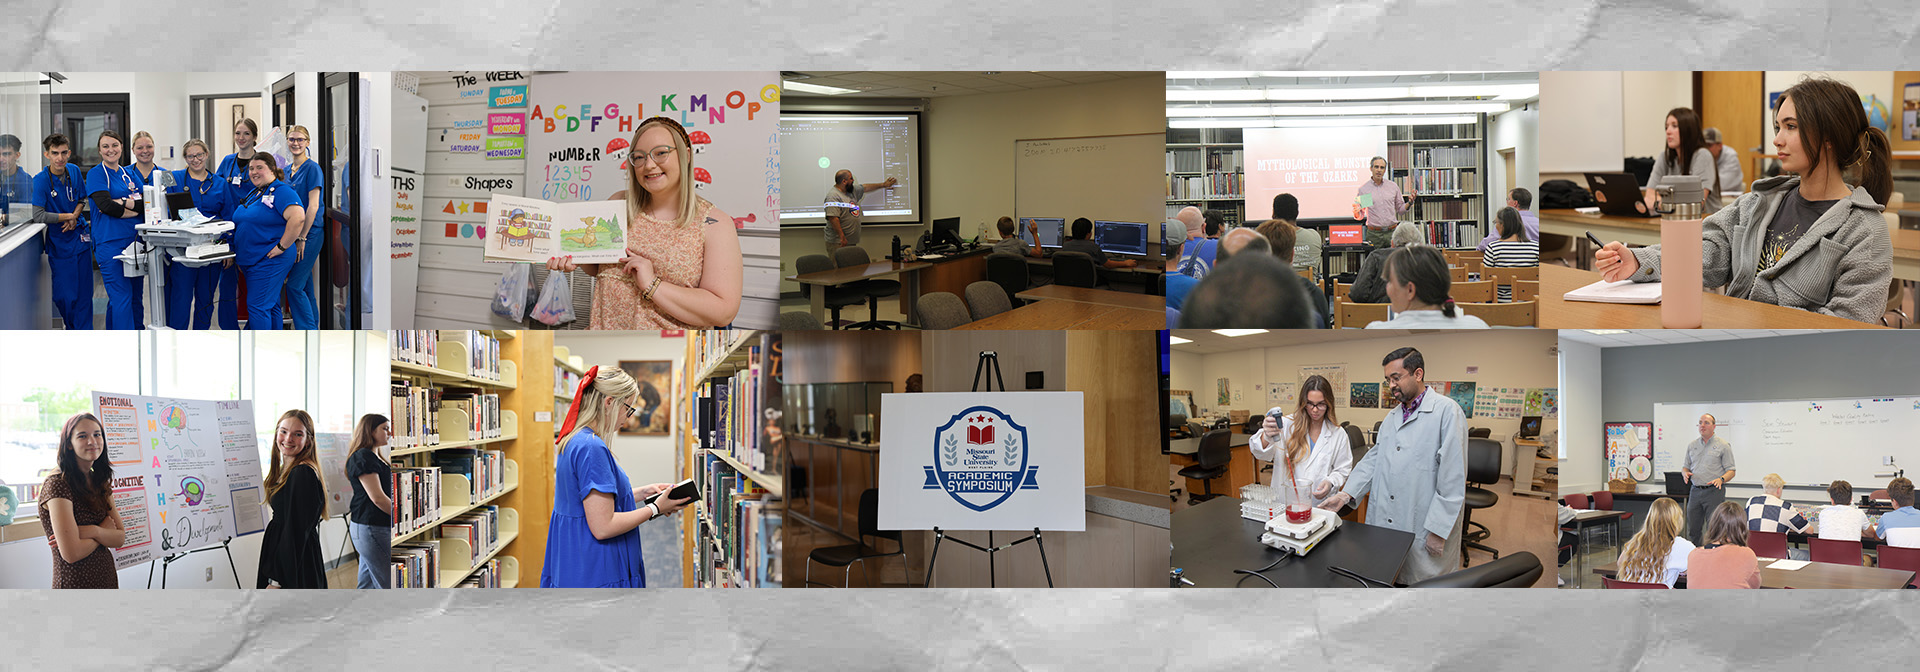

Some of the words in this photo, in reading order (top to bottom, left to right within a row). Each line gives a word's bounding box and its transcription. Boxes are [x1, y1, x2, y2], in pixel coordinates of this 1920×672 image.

[453, 76, 477, 88] The
[460, 89, 484, 97] SUNDAY
[495, 95, 523, 106] TUESDAY
[493, 124, 520, 133] MONDAY
[459, 133, 481, 141] FRIDAY
[486, 149, 522, 157] WEDNESDAY
[1257, 158, 1330, 171] MYTHOLOGICAL
[1285, 173, 1297, 184] OF
[1300, 171, 1319, 183] THE
[1323, 170, 1358, 182] OZARKS
[465, 176, 513, 192] Shapes
[397, 192, 408, 200] July
[99, 395, 133, 407] EMOTIONAL
[948, 472, 1013, 480] ACADEMIC
[947, 480, 1013, 492] SYMPOSIUM
